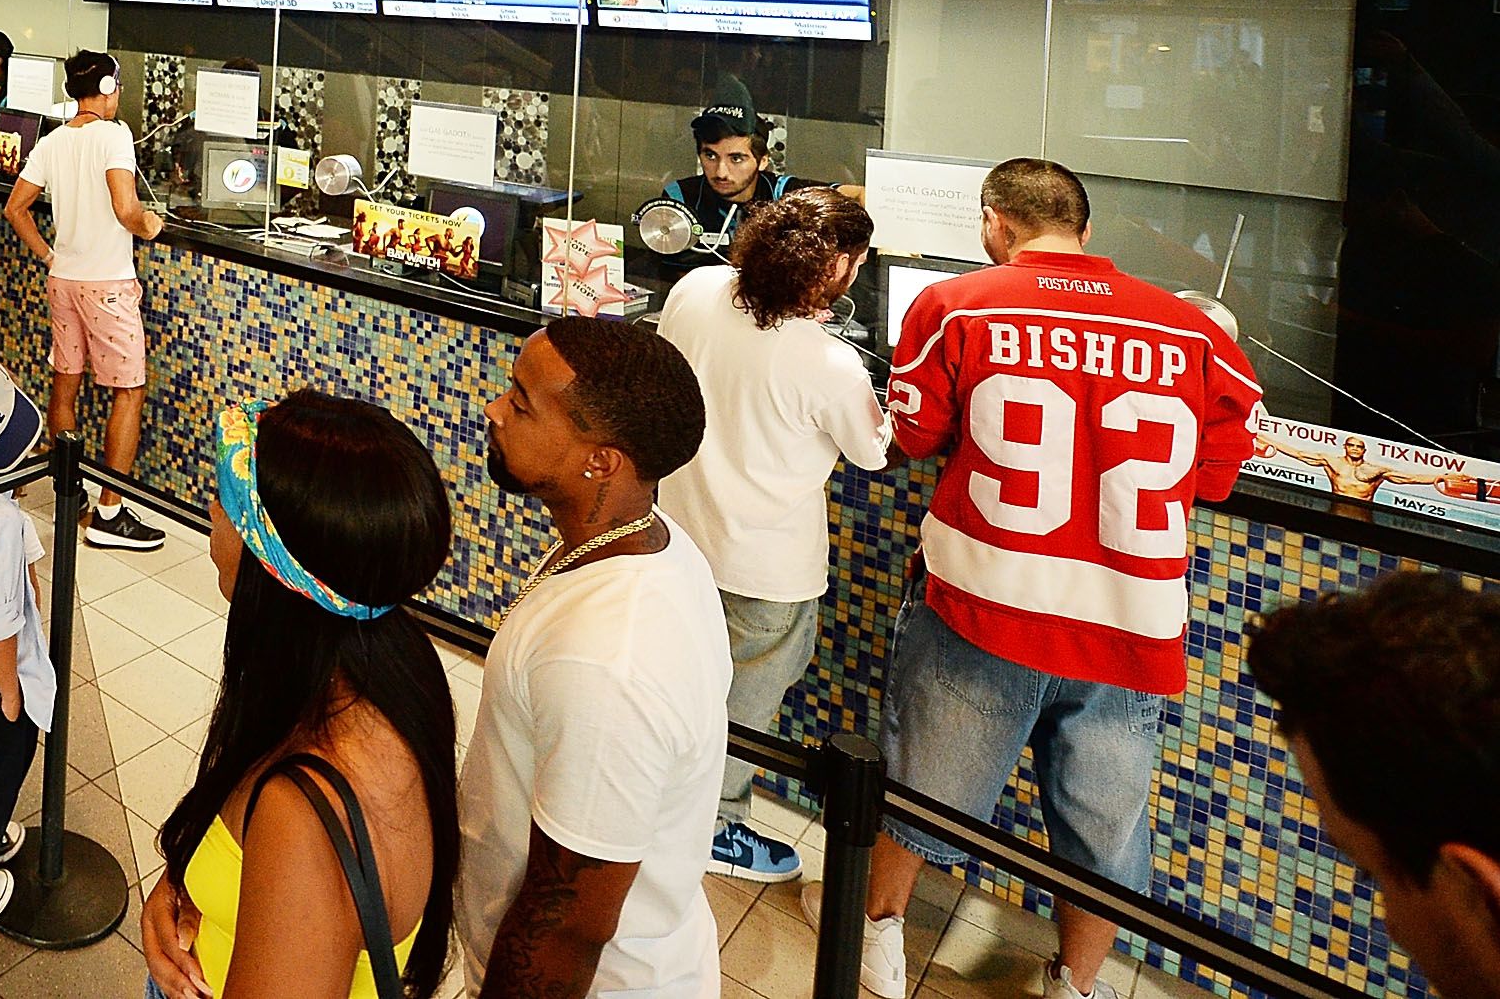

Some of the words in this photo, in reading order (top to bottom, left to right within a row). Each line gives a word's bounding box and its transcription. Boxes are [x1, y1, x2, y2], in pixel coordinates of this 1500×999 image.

[287, 0, 298, 7] 3D
[332, 1, 355, 10] $3.79
[896, 185, 917, 195] GAL
[921, 187, 962, 200] GADOT
[369, 204, 383, 212] GET
[385, 207, 406, 216] YOUR
[409, 211, 440, 224] TICKETS
[443, 219, 462, 228] NOW
[386, 248, 441, 269] BAYWATCH
[572, 282, 600, 303] HOPE
[987, 321, 1187, 387] BISHOP
[1258, 419, 1282, 435] ET
[1285, 424, 1337, 446] YOUR
[969, 373, 1198, 559] 92
[1377, 442, 1410, 462] TIX
[1413, 450, 1466, 473] NOW
[1242, 461, 1316, 486] AYWATCH
[1393, 496, 1427, 512] MAY
[1428, 504, 1446, 517] 25
